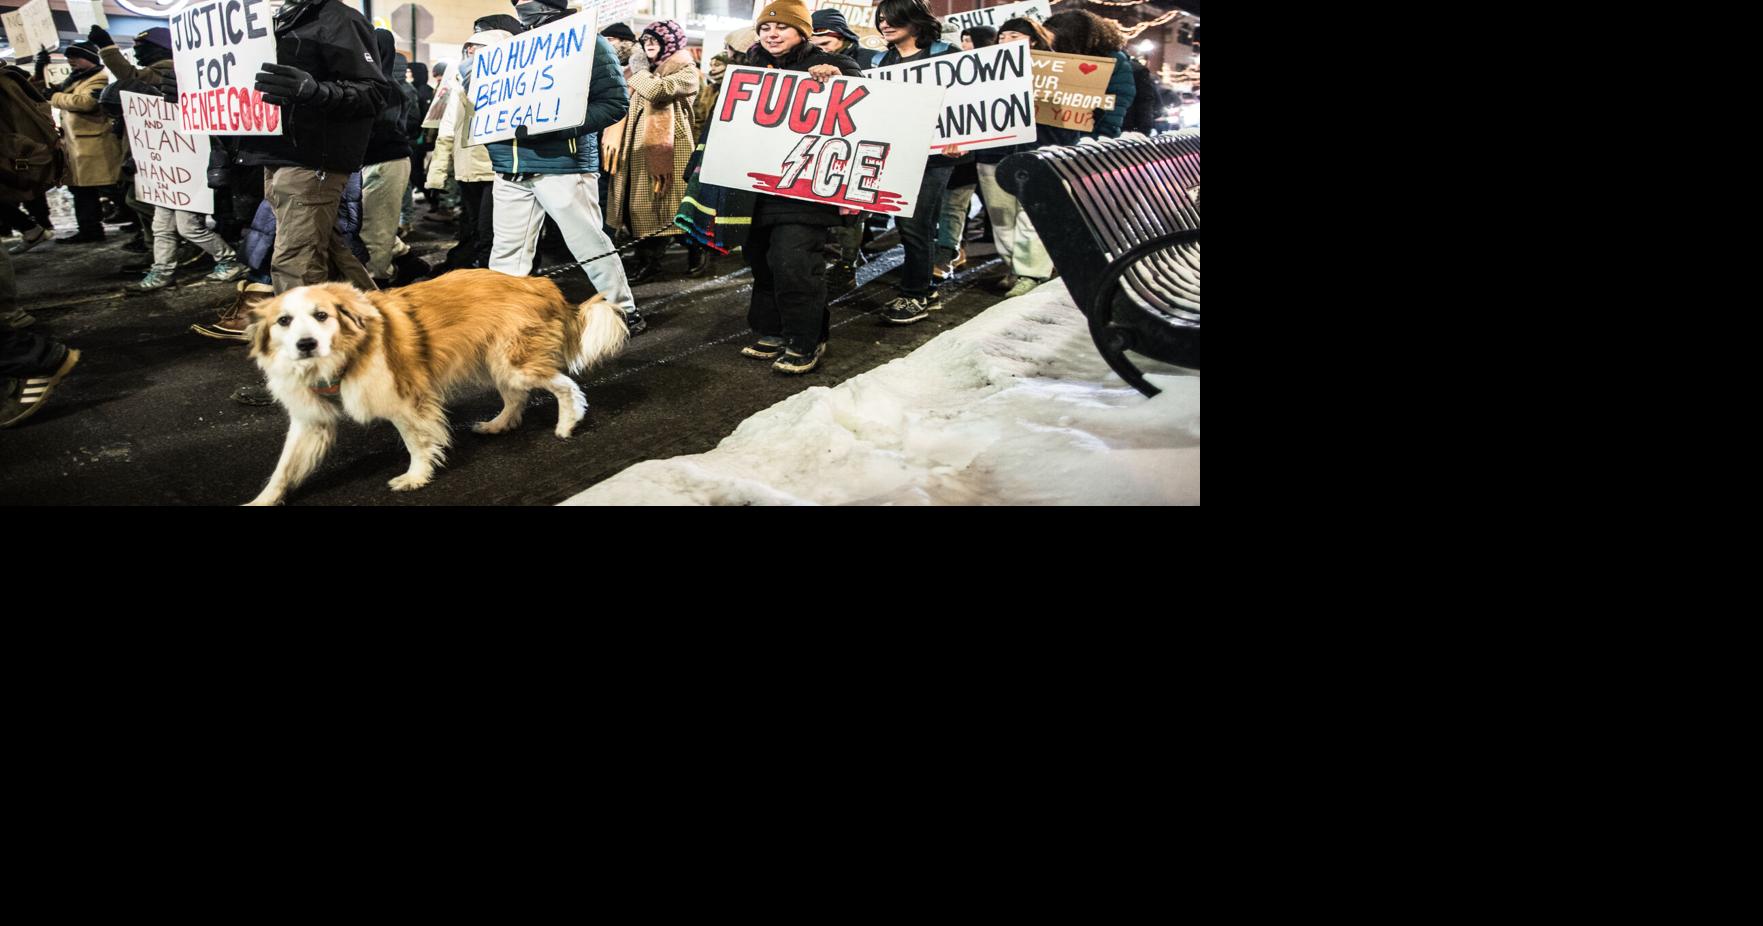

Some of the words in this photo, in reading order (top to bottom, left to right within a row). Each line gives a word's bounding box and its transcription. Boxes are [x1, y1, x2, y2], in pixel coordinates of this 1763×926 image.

[172, 0, 267, 51] JUSTICE
[948, 8, 995, 30] SHUT
[477, 47, 503, 78] NO
[506, 24, 587, 72] HUMAN
[935, 44, 1024, 88] DOWN
[1031, 60, 1067, 73] WE
[474, 72, 526, 111] BEING
[532, 65, 554, 93] IS
[1032, 75, 1060, 90] UR
[719, 69, 869, 137] FUCK
[1033, 89, 1116, 111] EIGHBORS
[144, 120, 163, 130] AND
[468, 97, 560, 139] ILLEGAL!
[132, 126, 196, 154] KLAN
[150, 152, 162, 162] GO
[776, 134, 890, 203] ICE
[138, 160, 192, 185] HAND
[142, 185, 191, 206] HAND
[157, 182, 169, 191] IN
